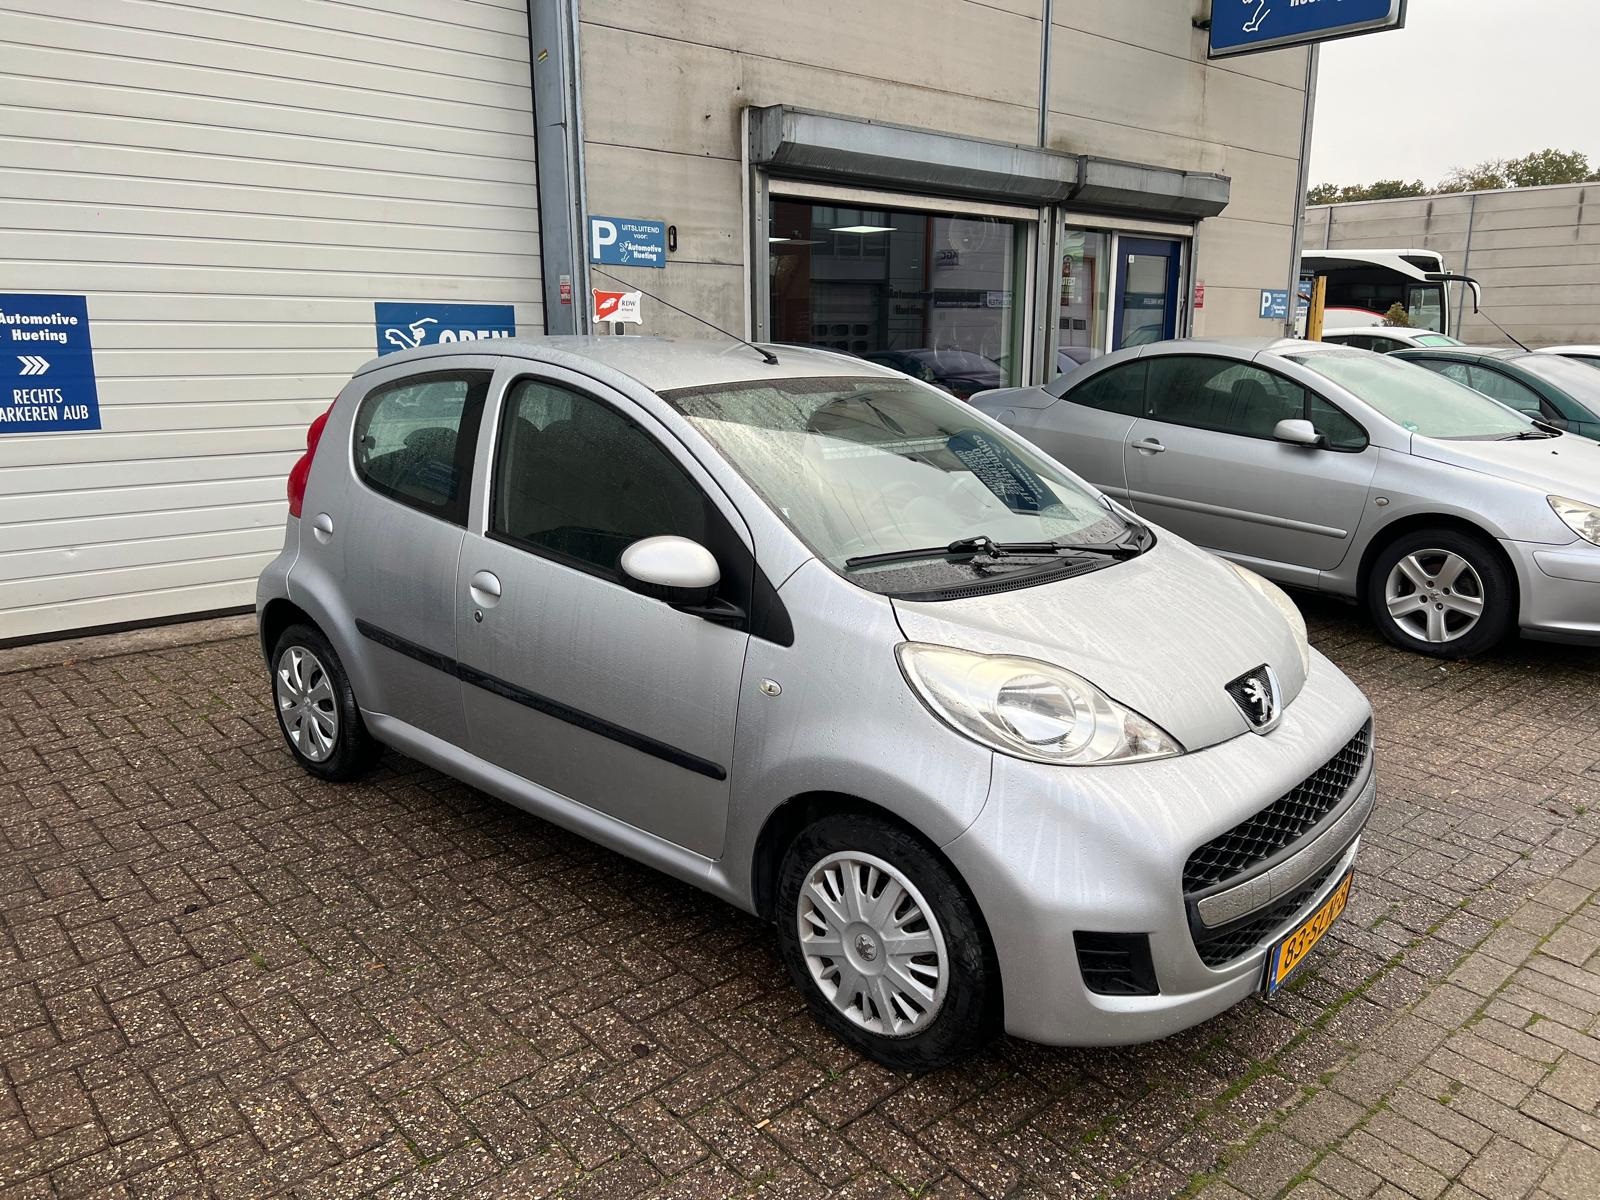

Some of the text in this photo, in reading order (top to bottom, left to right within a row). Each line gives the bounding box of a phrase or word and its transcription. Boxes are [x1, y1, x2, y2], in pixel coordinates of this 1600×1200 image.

[622, 225, 660, 234] UITSLUITEND
[592, 220, 617, 259] P
[628, 243, 662, 253] Automotive
[633, 251, 657, 261] Hueting
[1262, 292, 1272, 315] P
[11, 328, 68, 344] Hueting
[13, 388, 63, 405] RECHTS
[0, 404, 89, 422] ARKEREN AUB
